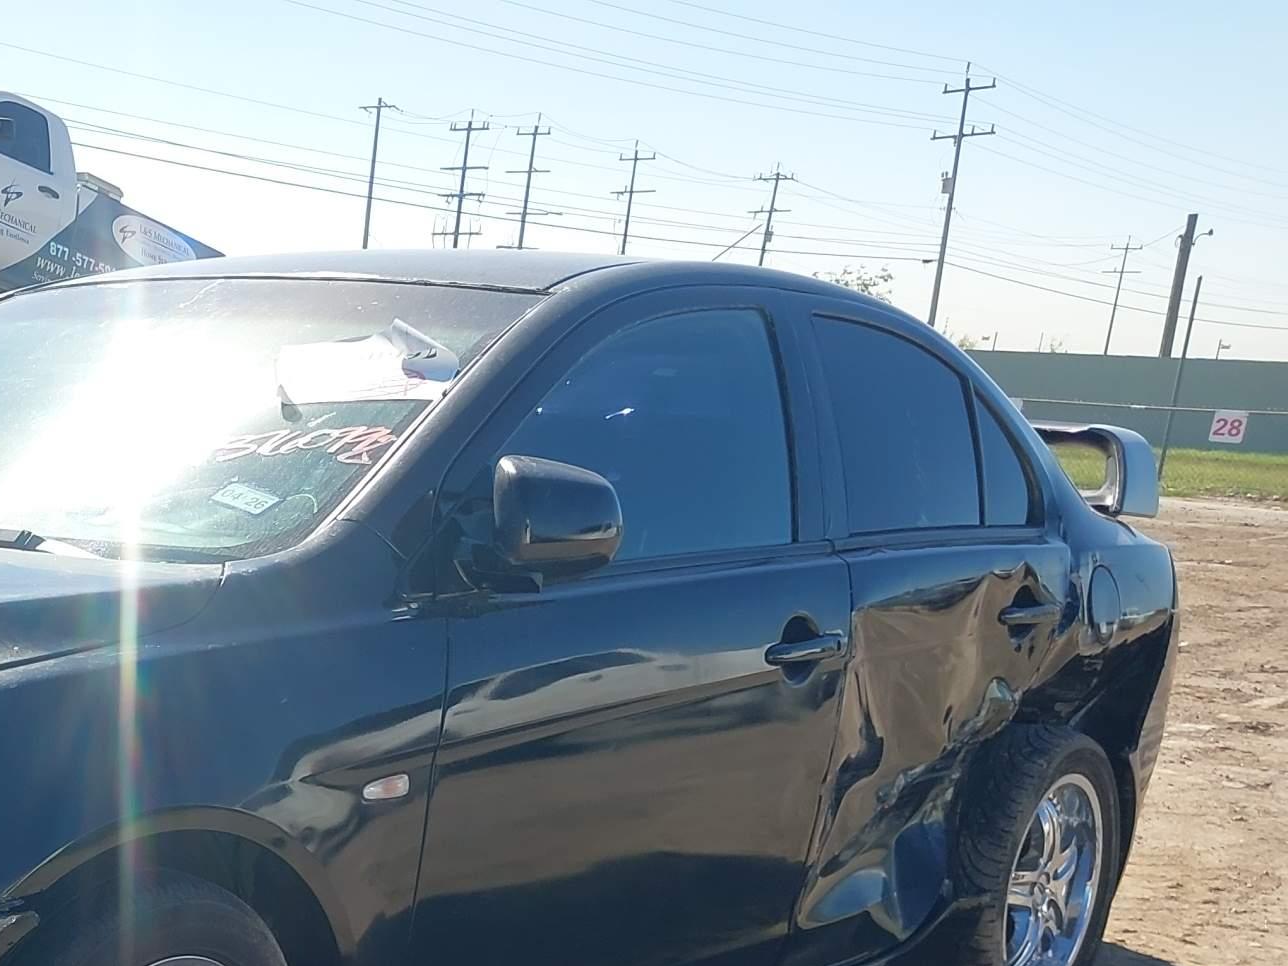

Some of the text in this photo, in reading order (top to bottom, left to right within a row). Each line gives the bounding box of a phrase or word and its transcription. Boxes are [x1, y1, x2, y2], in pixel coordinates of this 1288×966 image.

[49, 241, 69, 261] 877
[1212, 417, 1243, 437] 28
[220, 488, 268, 510] 04 26
